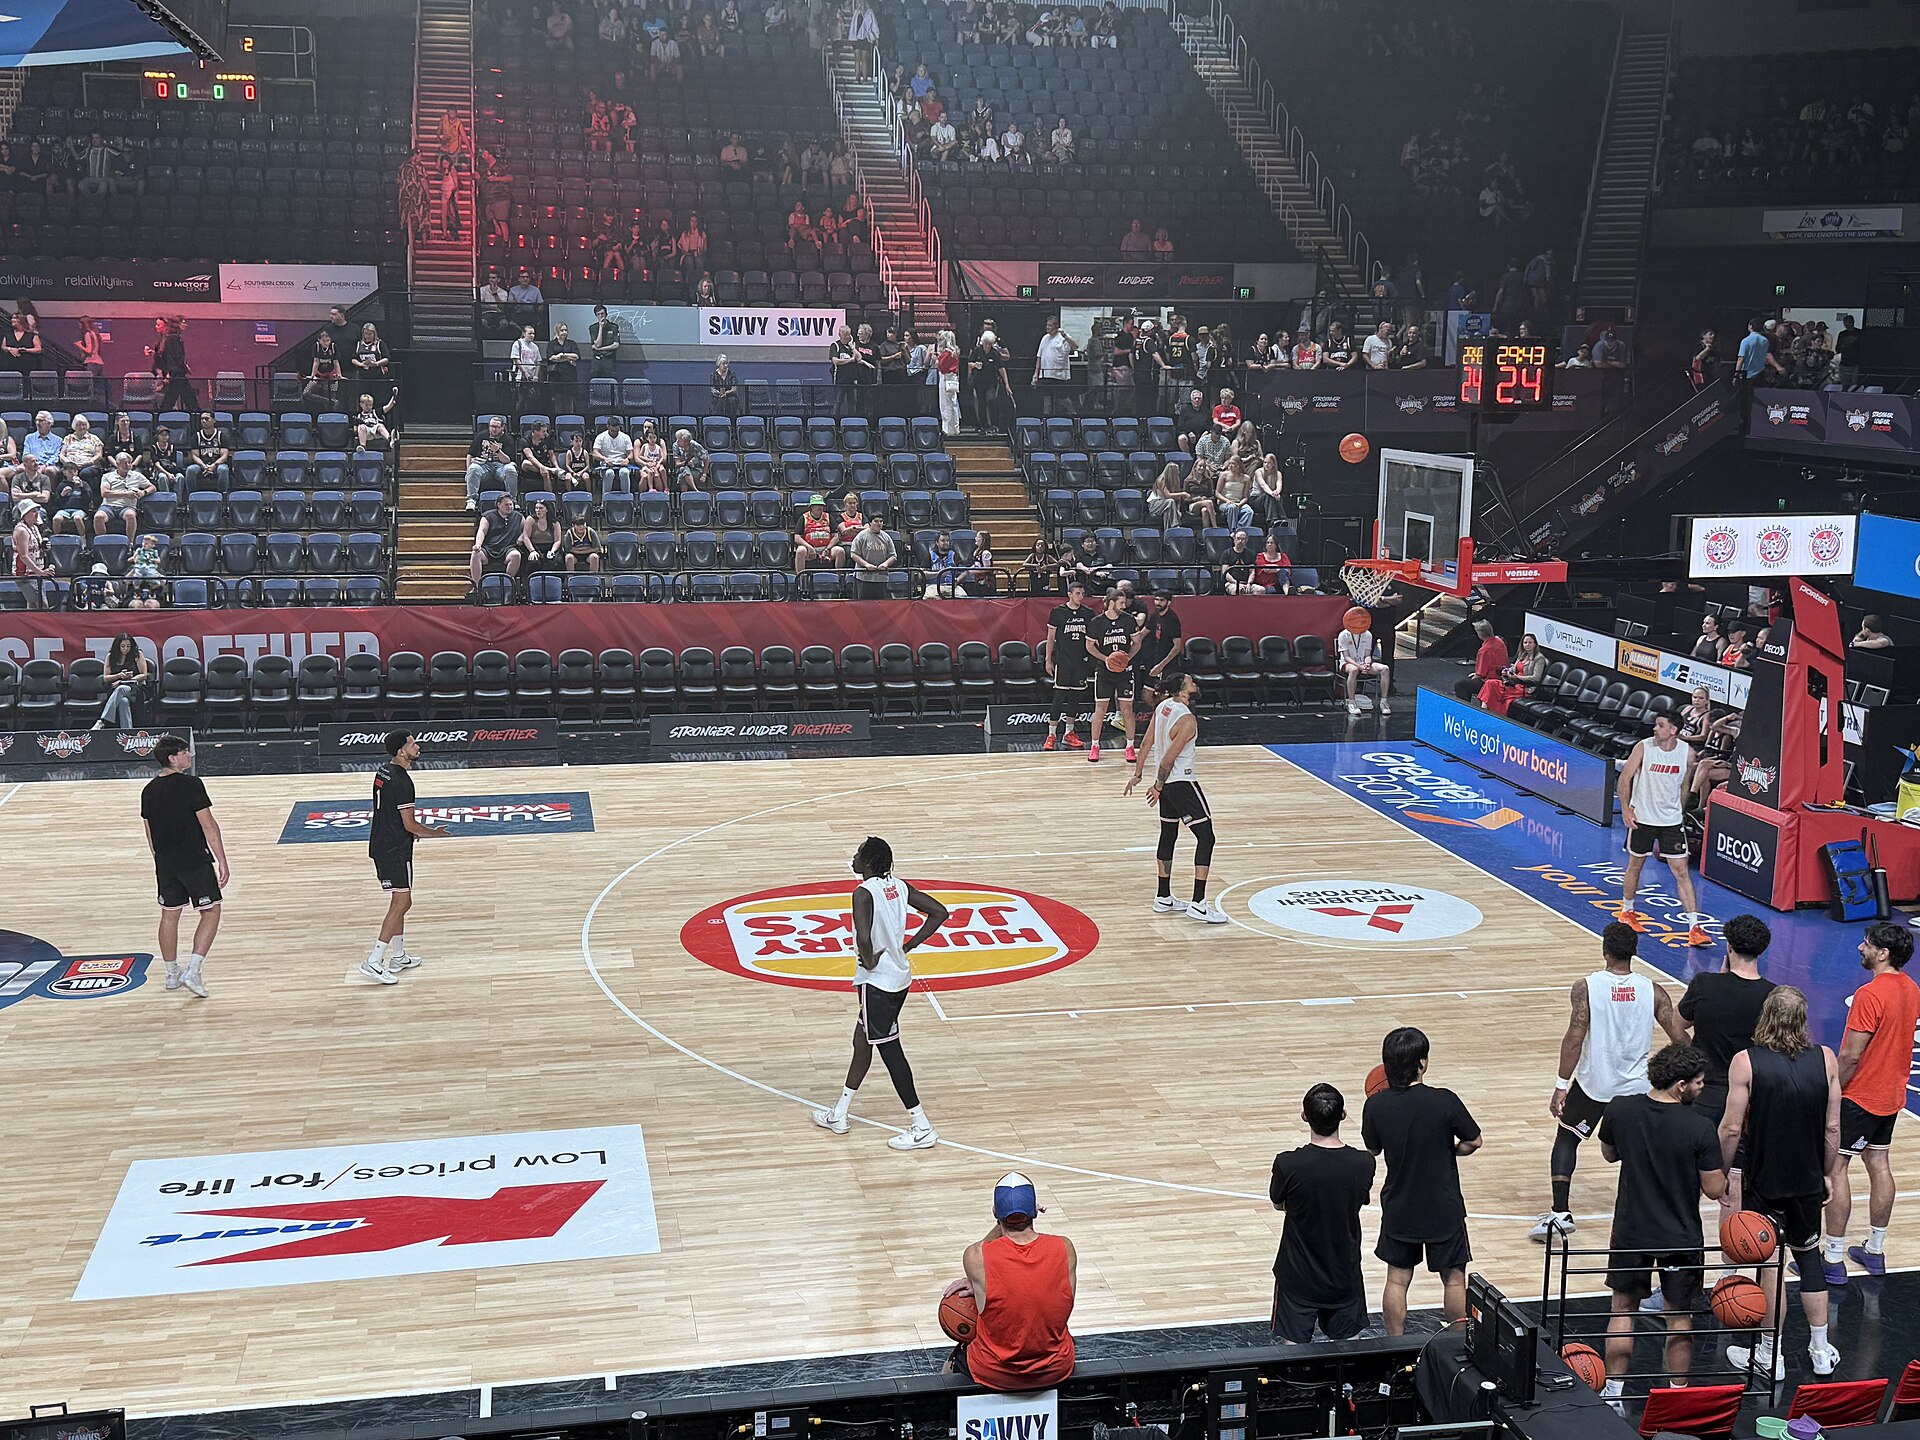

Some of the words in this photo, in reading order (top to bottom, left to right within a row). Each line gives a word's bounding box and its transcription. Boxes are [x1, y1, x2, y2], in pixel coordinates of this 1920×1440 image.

[157, 81, 168, 98] 0
[177, 83, 188, 98] 0
[213, 84, 224, 100] 0
[245, 84, 255, 100] 0
[1786, 231, 1802, 239] HOPE
[1804, 231, 1816, 239] YOU
[1857, 230, 1878, 238] SHOW
[64, 275, 134, 289] relativityfilms
[1047, 275, 1096, 285] STRONGER
[1118, 275, 1155, 285] LOUDER
[708, 315, 770, 337] SAVVY
[777, 316, 838, 337] SAVVY
[1496, 346, 1545, 365] 29:43
[1461, 366, 1482, 402] 24
[1495, 366, 1543, 404] 24
[1400, 400, 1422, 410] HAWKS
[1663, 432, 1688, 456] HAWKS
[1579, 494, 1604, 517] HAWKS
[1702, 525, 1740, 541] WALLAWA
[1756, 524, 1792, 541] WALLAWA
[1808, 523, 1844, 539] WALLAWA
[1706, 558, 1735, 570] TRAFFIC
[1759, 557, 1788, 569] TRAFFIC
[1811, 556, 1840, 568] TRAFFIC
[1064, 624, 1087, 634] HAWKS
[1103, 635, 1127, 646] HAWKS
[1556, 630, 1586, 647] VIRTUAL
[1764, 643, 1780, 655] DECO
[1691, 671, 1723, 685] ATTWOOD
[416, 730, 468, 743] LOUDER
[471, 728, 538, 742] TOGETHER
[669, 724, 736, 740] STRONGER
[739, 723, 788, 738] LOUDER
[791, 722, 853, 737] TOGETHER
[47, 738, 82, 751] HAWKS
[1444, 712, 1478, 746] We've
[1480, 733, 1500, 755] got
[1502, 742, 1529, 768] your
[1530, 748, 1568, 785] back!
[1361, 752, 1498, 805] Greater
[1742, 767, 1769, 788] HAWKS
[376, 789, 381, 810] 1
[1338, 774, 1443, 810] Bank
[1717, 832, 1752, 863] DECO
[1512, 864, 1609, 897] your
[1276, 893, 1425, 906] MITSUBISHI
[1287, 887, 1396, 899] MOTORS
[70, 977, 113, 989] NBL
[515, 1149, 608, 1168] Low
[158, 1177, 234, 1198] life
[965, 1413, 1050, 1440] SAVVY
